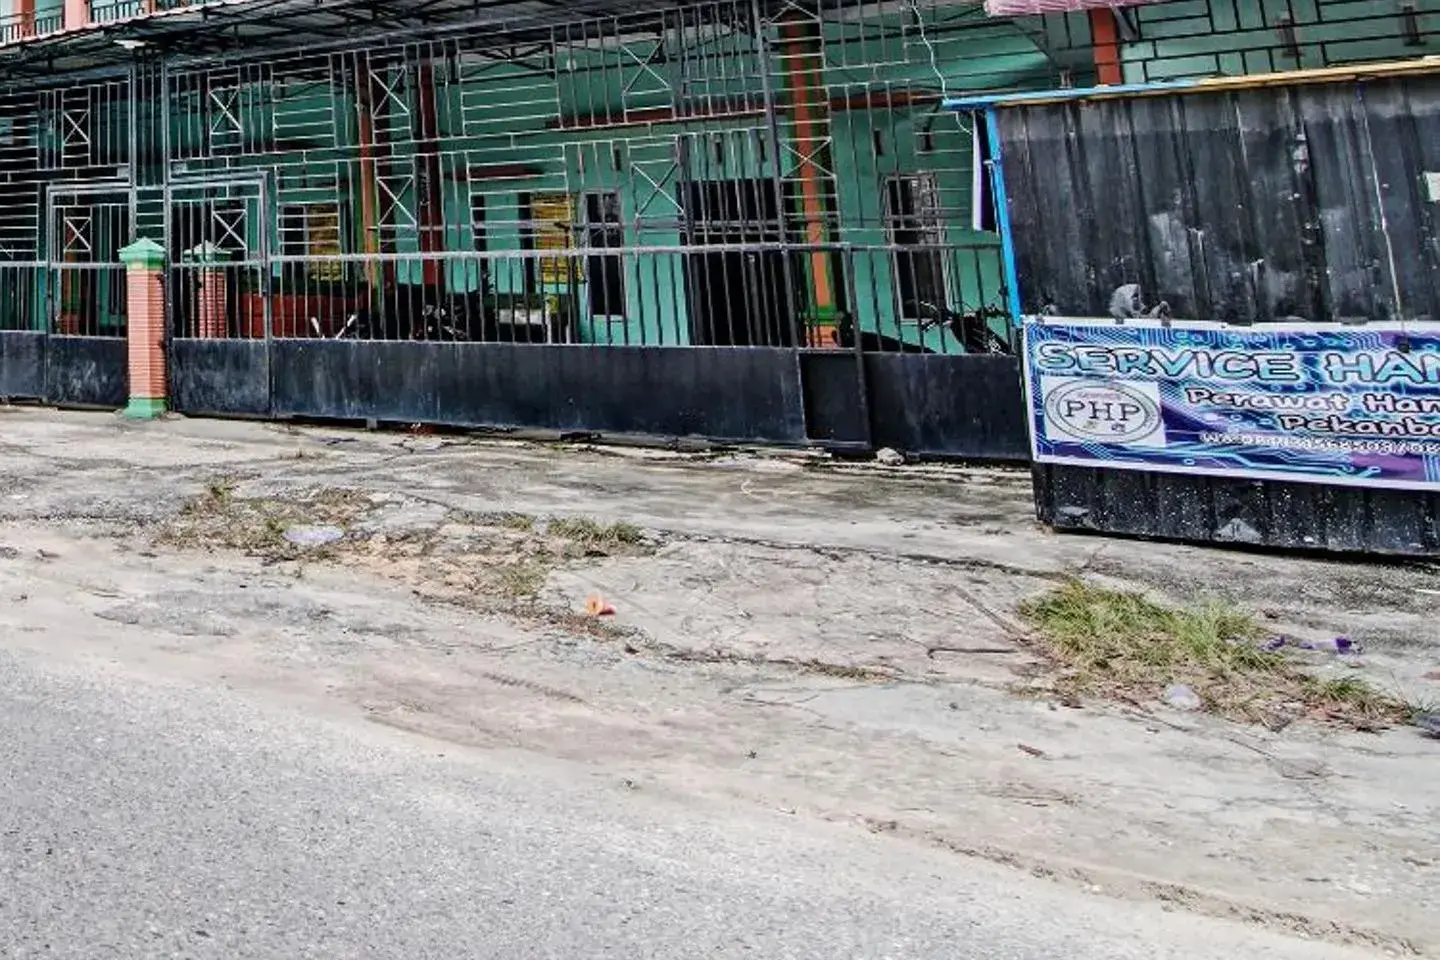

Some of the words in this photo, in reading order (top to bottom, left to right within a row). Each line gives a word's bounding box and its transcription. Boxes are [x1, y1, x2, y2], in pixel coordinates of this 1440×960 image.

[1037, 342, 1299, 382] SERVICE
[1064, 400, 1141, 421] PHP
[1187, 387, 1350, 411] Perawat
